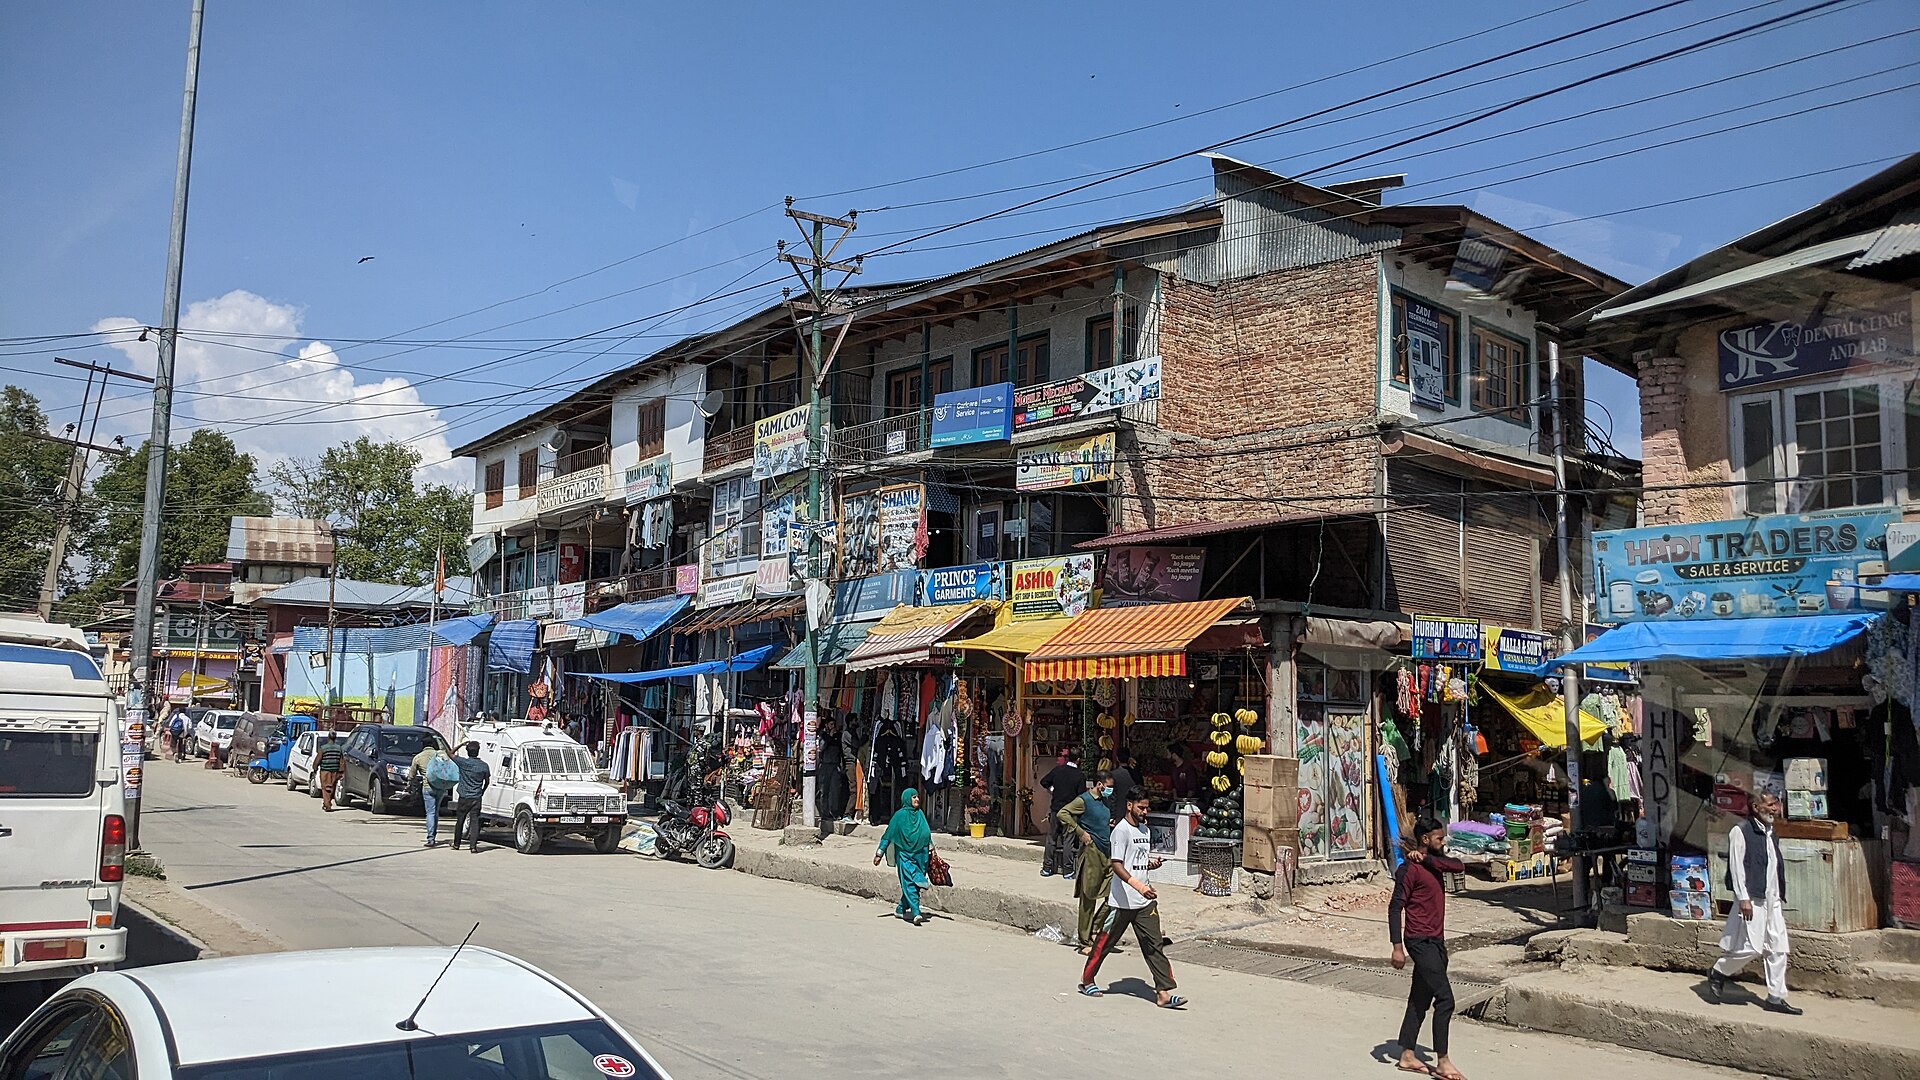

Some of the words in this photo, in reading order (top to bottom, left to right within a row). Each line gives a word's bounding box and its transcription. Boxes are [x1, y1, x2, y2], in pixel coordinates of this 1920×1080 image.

[1408, 311, 1438, 329] TECHNOLOGIES
[1416, 304, 1431, 318] ZADI
[1804, 322, 1856, 345] DENTAL
[1860, 310, 1908, 334] CLINIC
[1720, 319, 1799, 383] JK
[1829, 344, 1857, 361] AND
[1860, 337, 1888, 355] LAB
[1014, 391, 1041, 407] MOBILE
[1043, 381, 1085, 401] MECHANICS
[956, 409, 976, 418] Service
[1054, 404, 1071, 415] LAVA
[758, 408, 808, 440] SAMI.COM
[882, 490, 920, 508] SHANU
[1624, 533, 1701, 566] HADI
[1706, 523, 1858, 560] TRADERS
[1689, 564, 1721, 577] SALE
[1722, 563, 1732, 576] &
[1733, 559, 1790, 575] SERVICE
[933, 569, 977, 588] PRINCE
[1015, 570, 1054, 591] ASHIQ
[935, 586, 976, 601] GARMENTS
[1034, 590, 1054, 599] DECORATION
[1414, 620, 1444, 638] HURRAH
[1447, 622, 1478, 640] TRADERS
[1500, 636, 1521, 654] MALLA
[1522, 640, 1527, 655] &
[1503, 654, 1524, 664] KIRYANA
[1524, 656, 1538, 666] ITEMS
